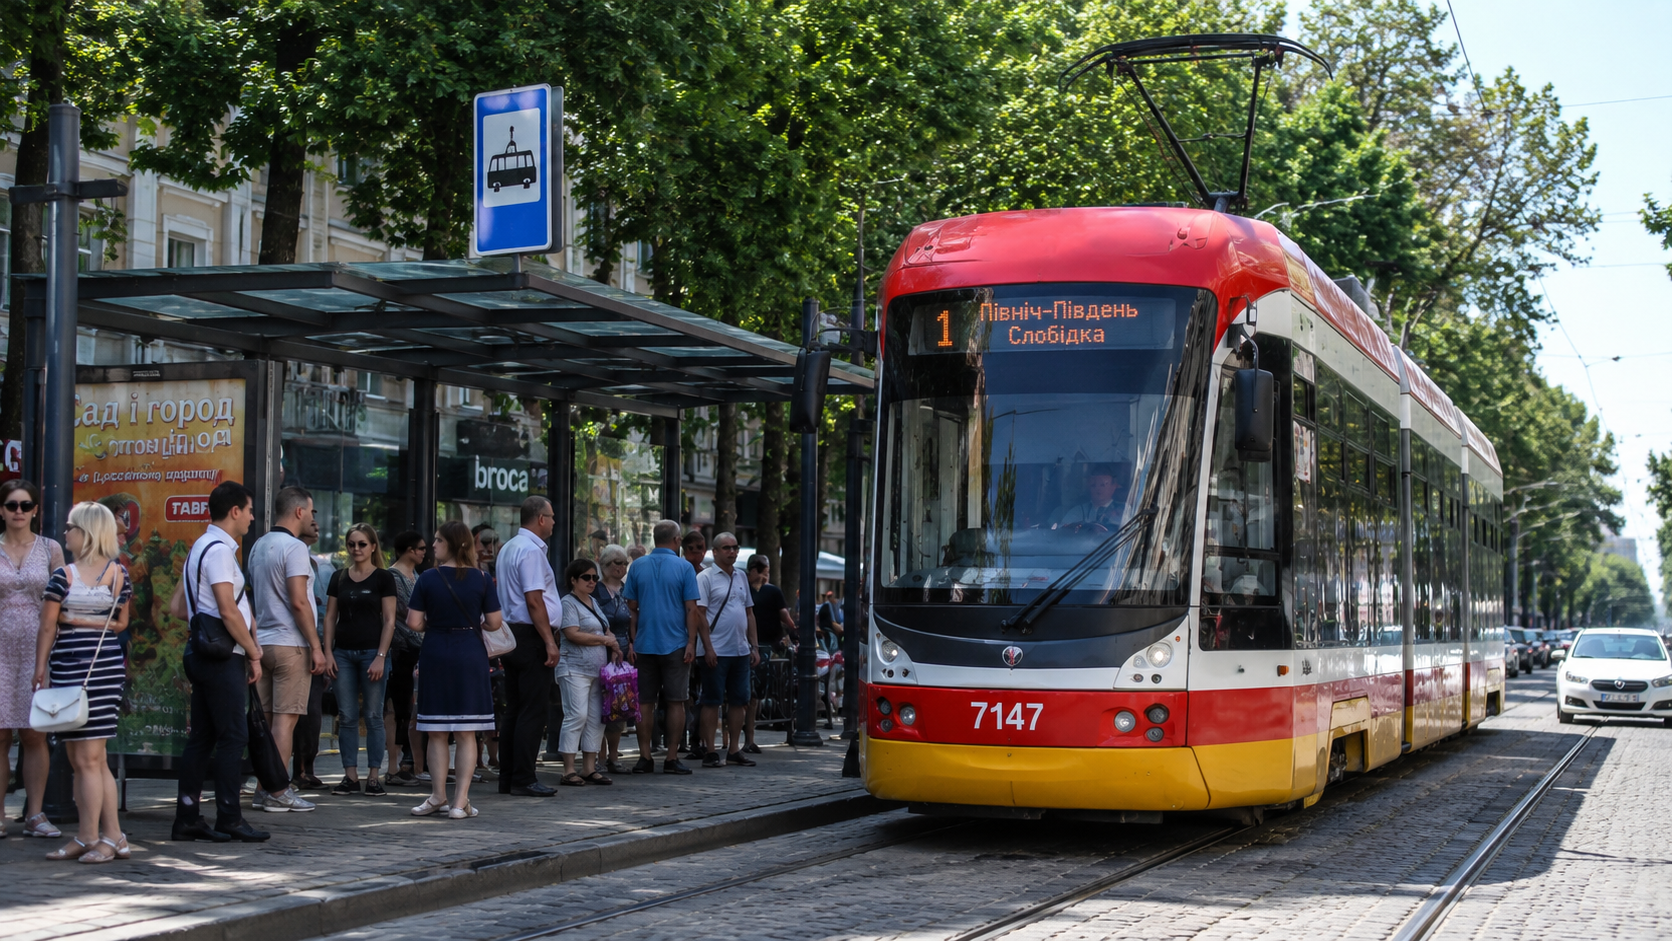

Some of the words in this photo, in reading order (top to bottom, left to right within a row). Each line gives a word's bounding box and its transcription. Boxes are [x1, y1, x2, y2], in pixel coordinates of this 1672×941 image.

[980, 300, 1139, 322] Північ-Південь
[937, 310, 953, 347] 1
[1008, 325, 1105, 345] Слобідка
[146, 397, 235, 429] город
[970, 702, 1044, 731] 7147
